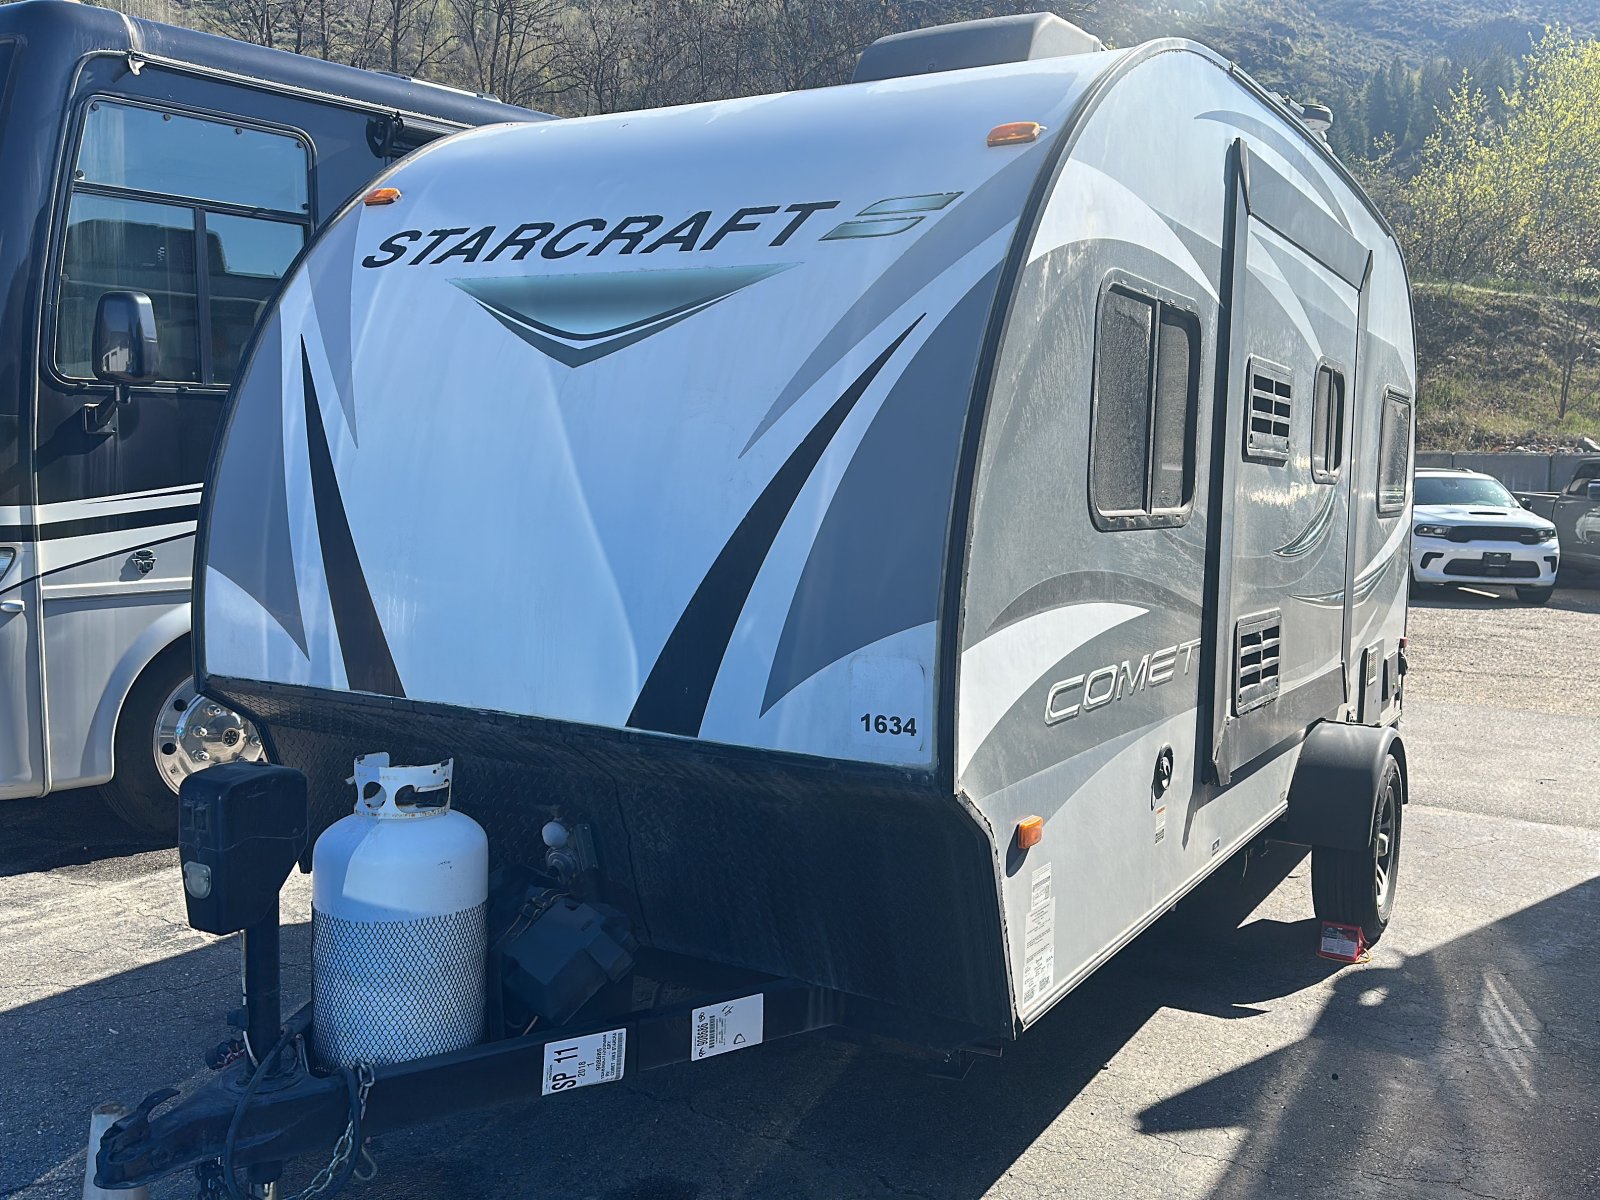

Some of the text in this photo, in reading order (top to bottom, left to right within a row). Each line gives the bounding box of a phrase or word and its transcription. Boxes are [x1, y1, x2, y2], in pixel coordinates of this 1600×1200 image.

[361, 200, 841, 269] STARCRAFT
[1044, 639, 1201, 727] COMET
[860, 713, 918, 737] 1634
[552, 1047, 578, 1091] SP 11
[578, 1061, 586, 1078] 2018
